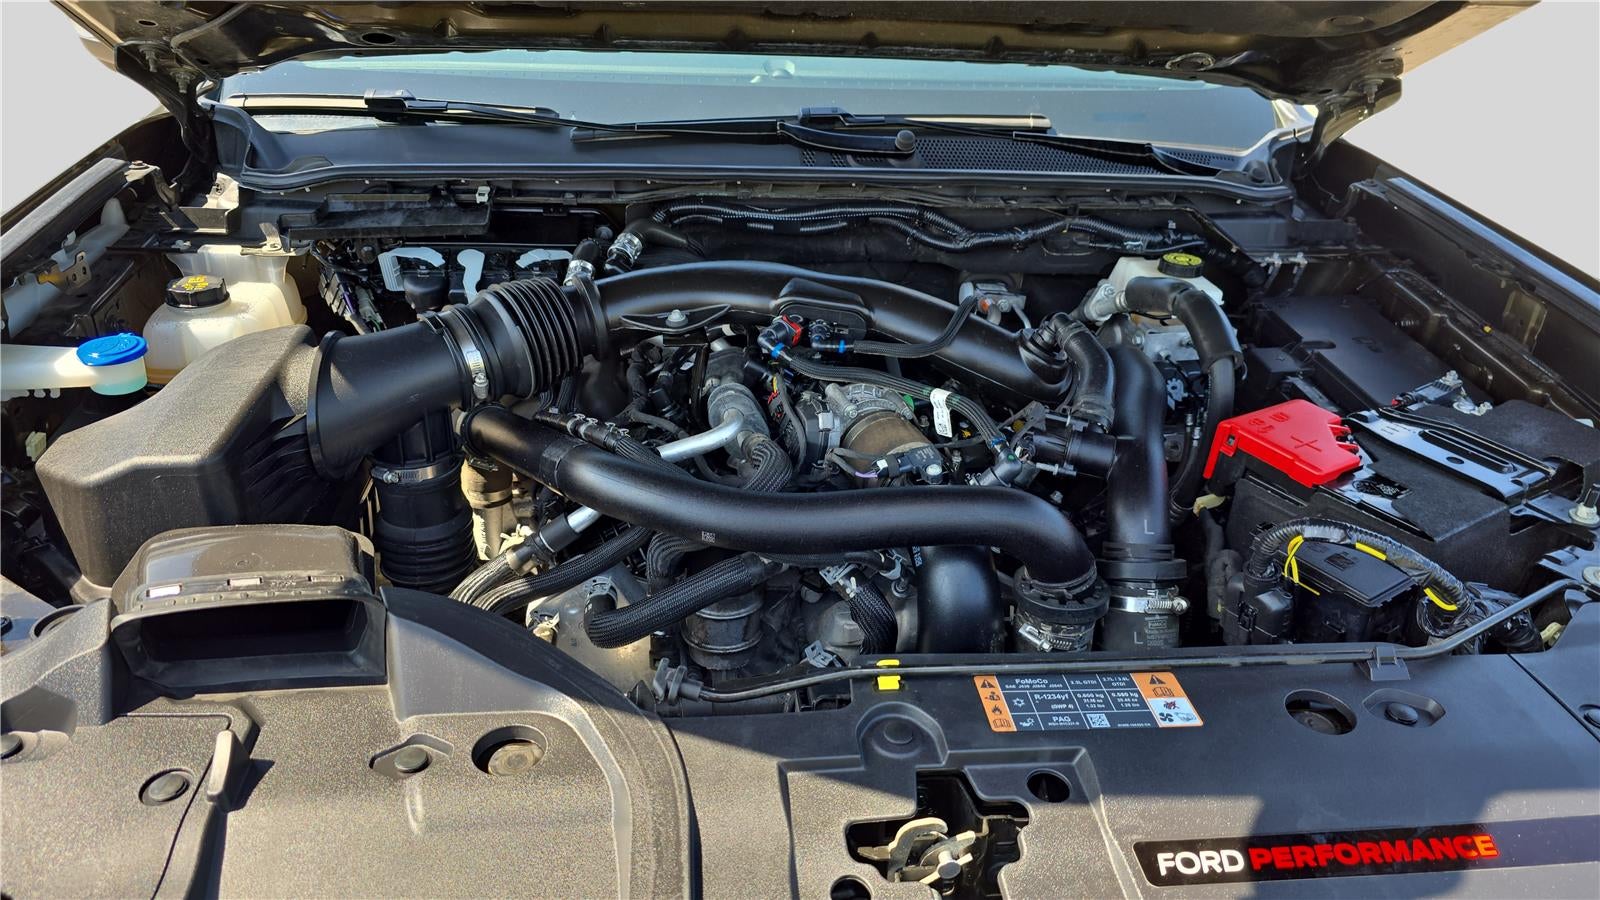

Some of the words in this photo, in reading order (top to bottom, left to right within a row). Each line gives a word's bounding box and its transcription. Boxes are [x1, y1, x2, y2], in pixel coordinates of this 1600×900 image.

[1143, 519, 1155, 535] L
[1133, 631, 1144, 645] L
[1033, 693, 1070, 701] R-1234yf
[1156, 849, 1245, 877] FORD
[1248, 833, 1500, 872] PERFORMANCE
